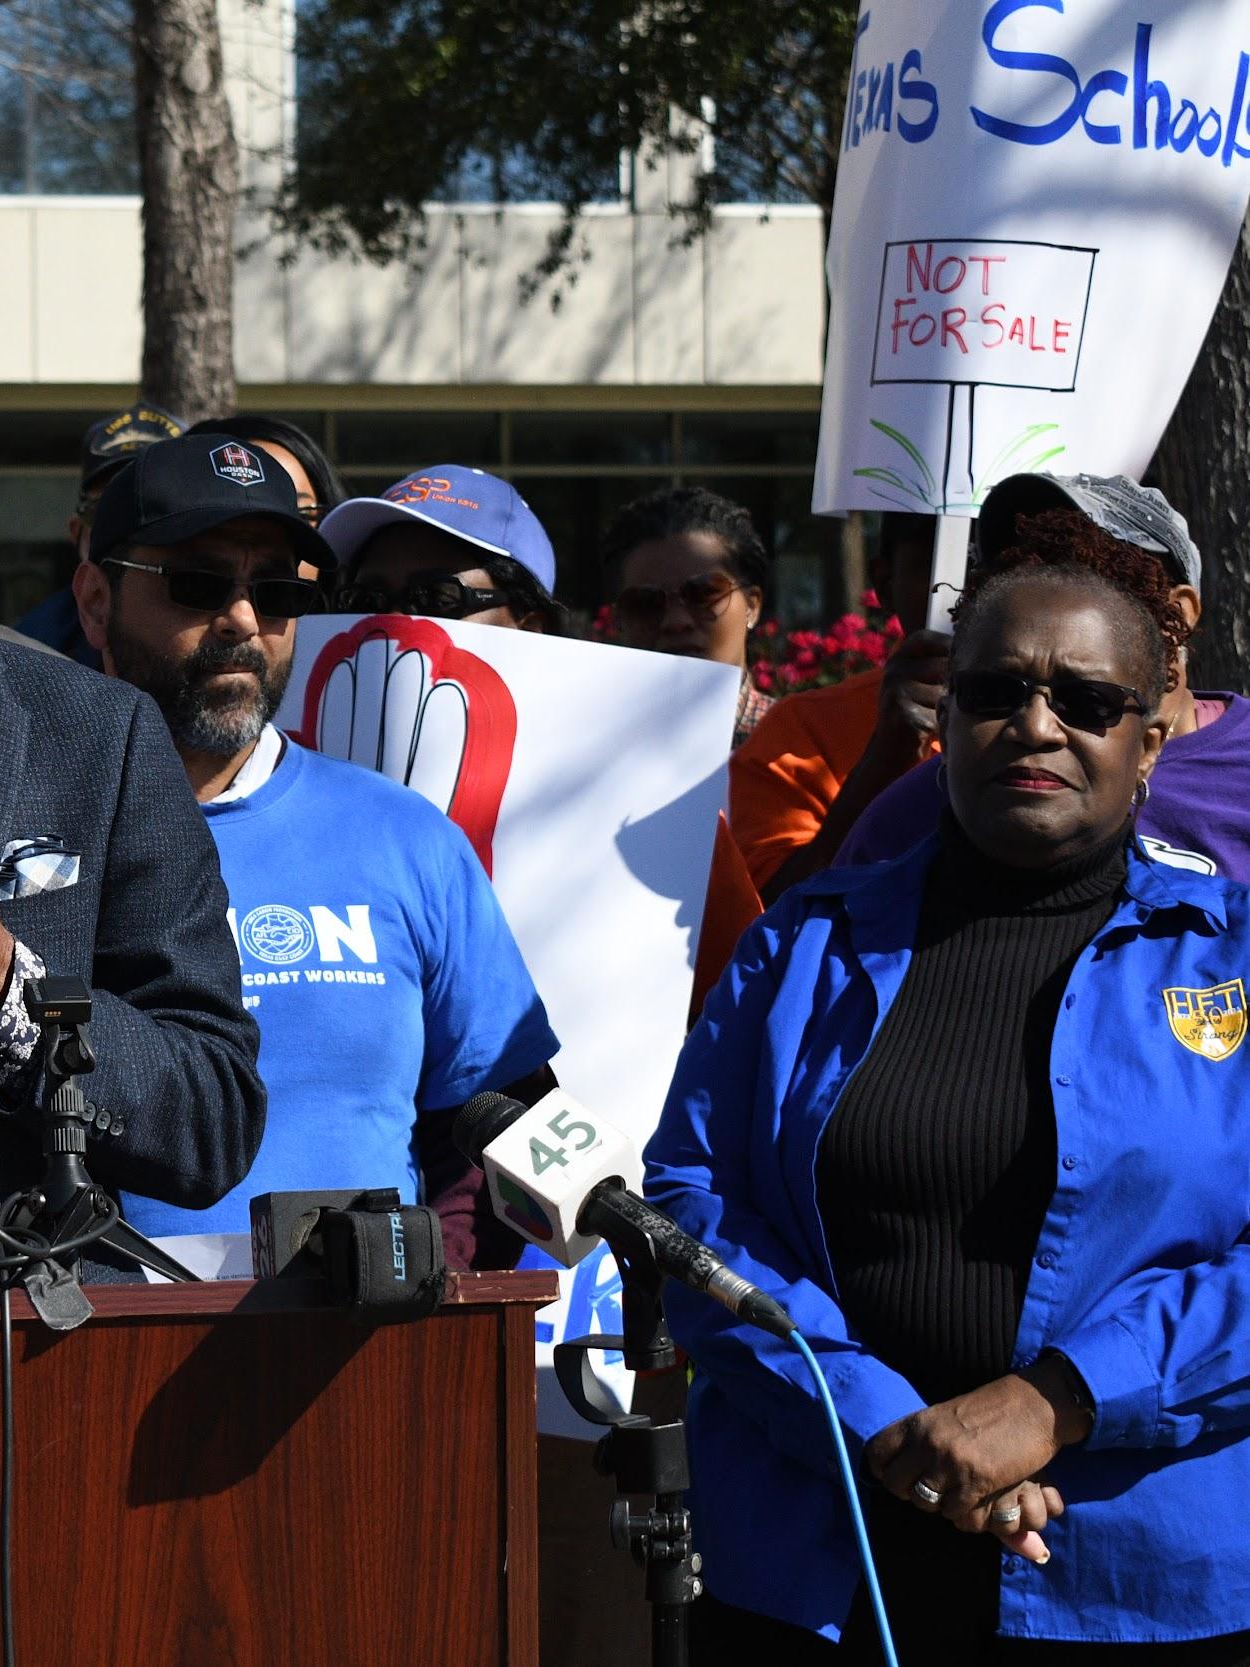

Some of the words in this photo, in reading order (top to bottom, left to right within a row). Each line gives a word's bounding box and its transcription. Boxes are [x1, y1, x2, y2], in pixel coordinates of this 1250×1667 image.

[906, 243, 1007, 297] NOT
[891, 298, 969, 355] FOR
[980, 303, 1073, 354] SALE
[220, 466, 260, 478] HOUSTON
[242, 971, 301, 986] COAST
[304, 970, 386, 985] WORKERS
[528, 1109, 597, 1176] 45
